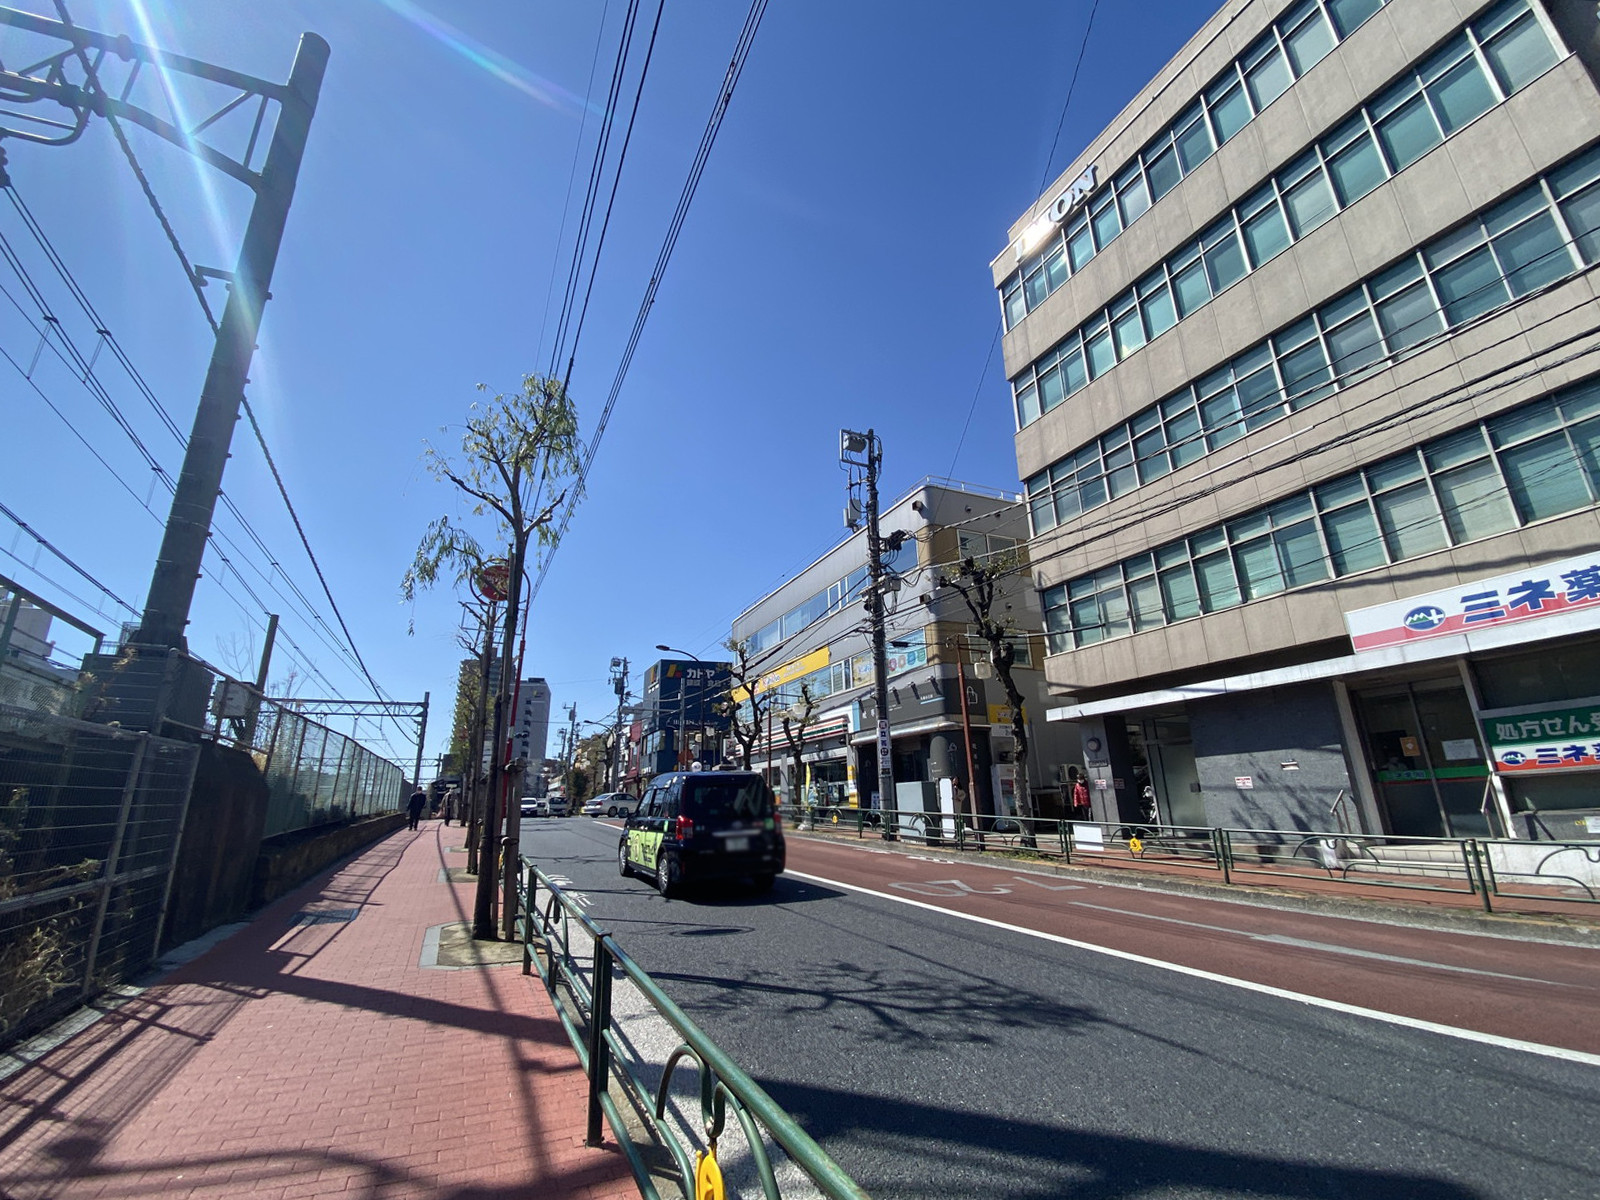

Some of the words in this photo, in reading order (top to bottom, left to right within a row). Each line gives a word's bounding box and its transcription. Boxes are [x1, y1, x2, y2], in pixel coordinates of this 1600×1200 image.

[1460, 565, 1600, 623] ミネ薬
[686, 668, 715, 679] カトヤ
